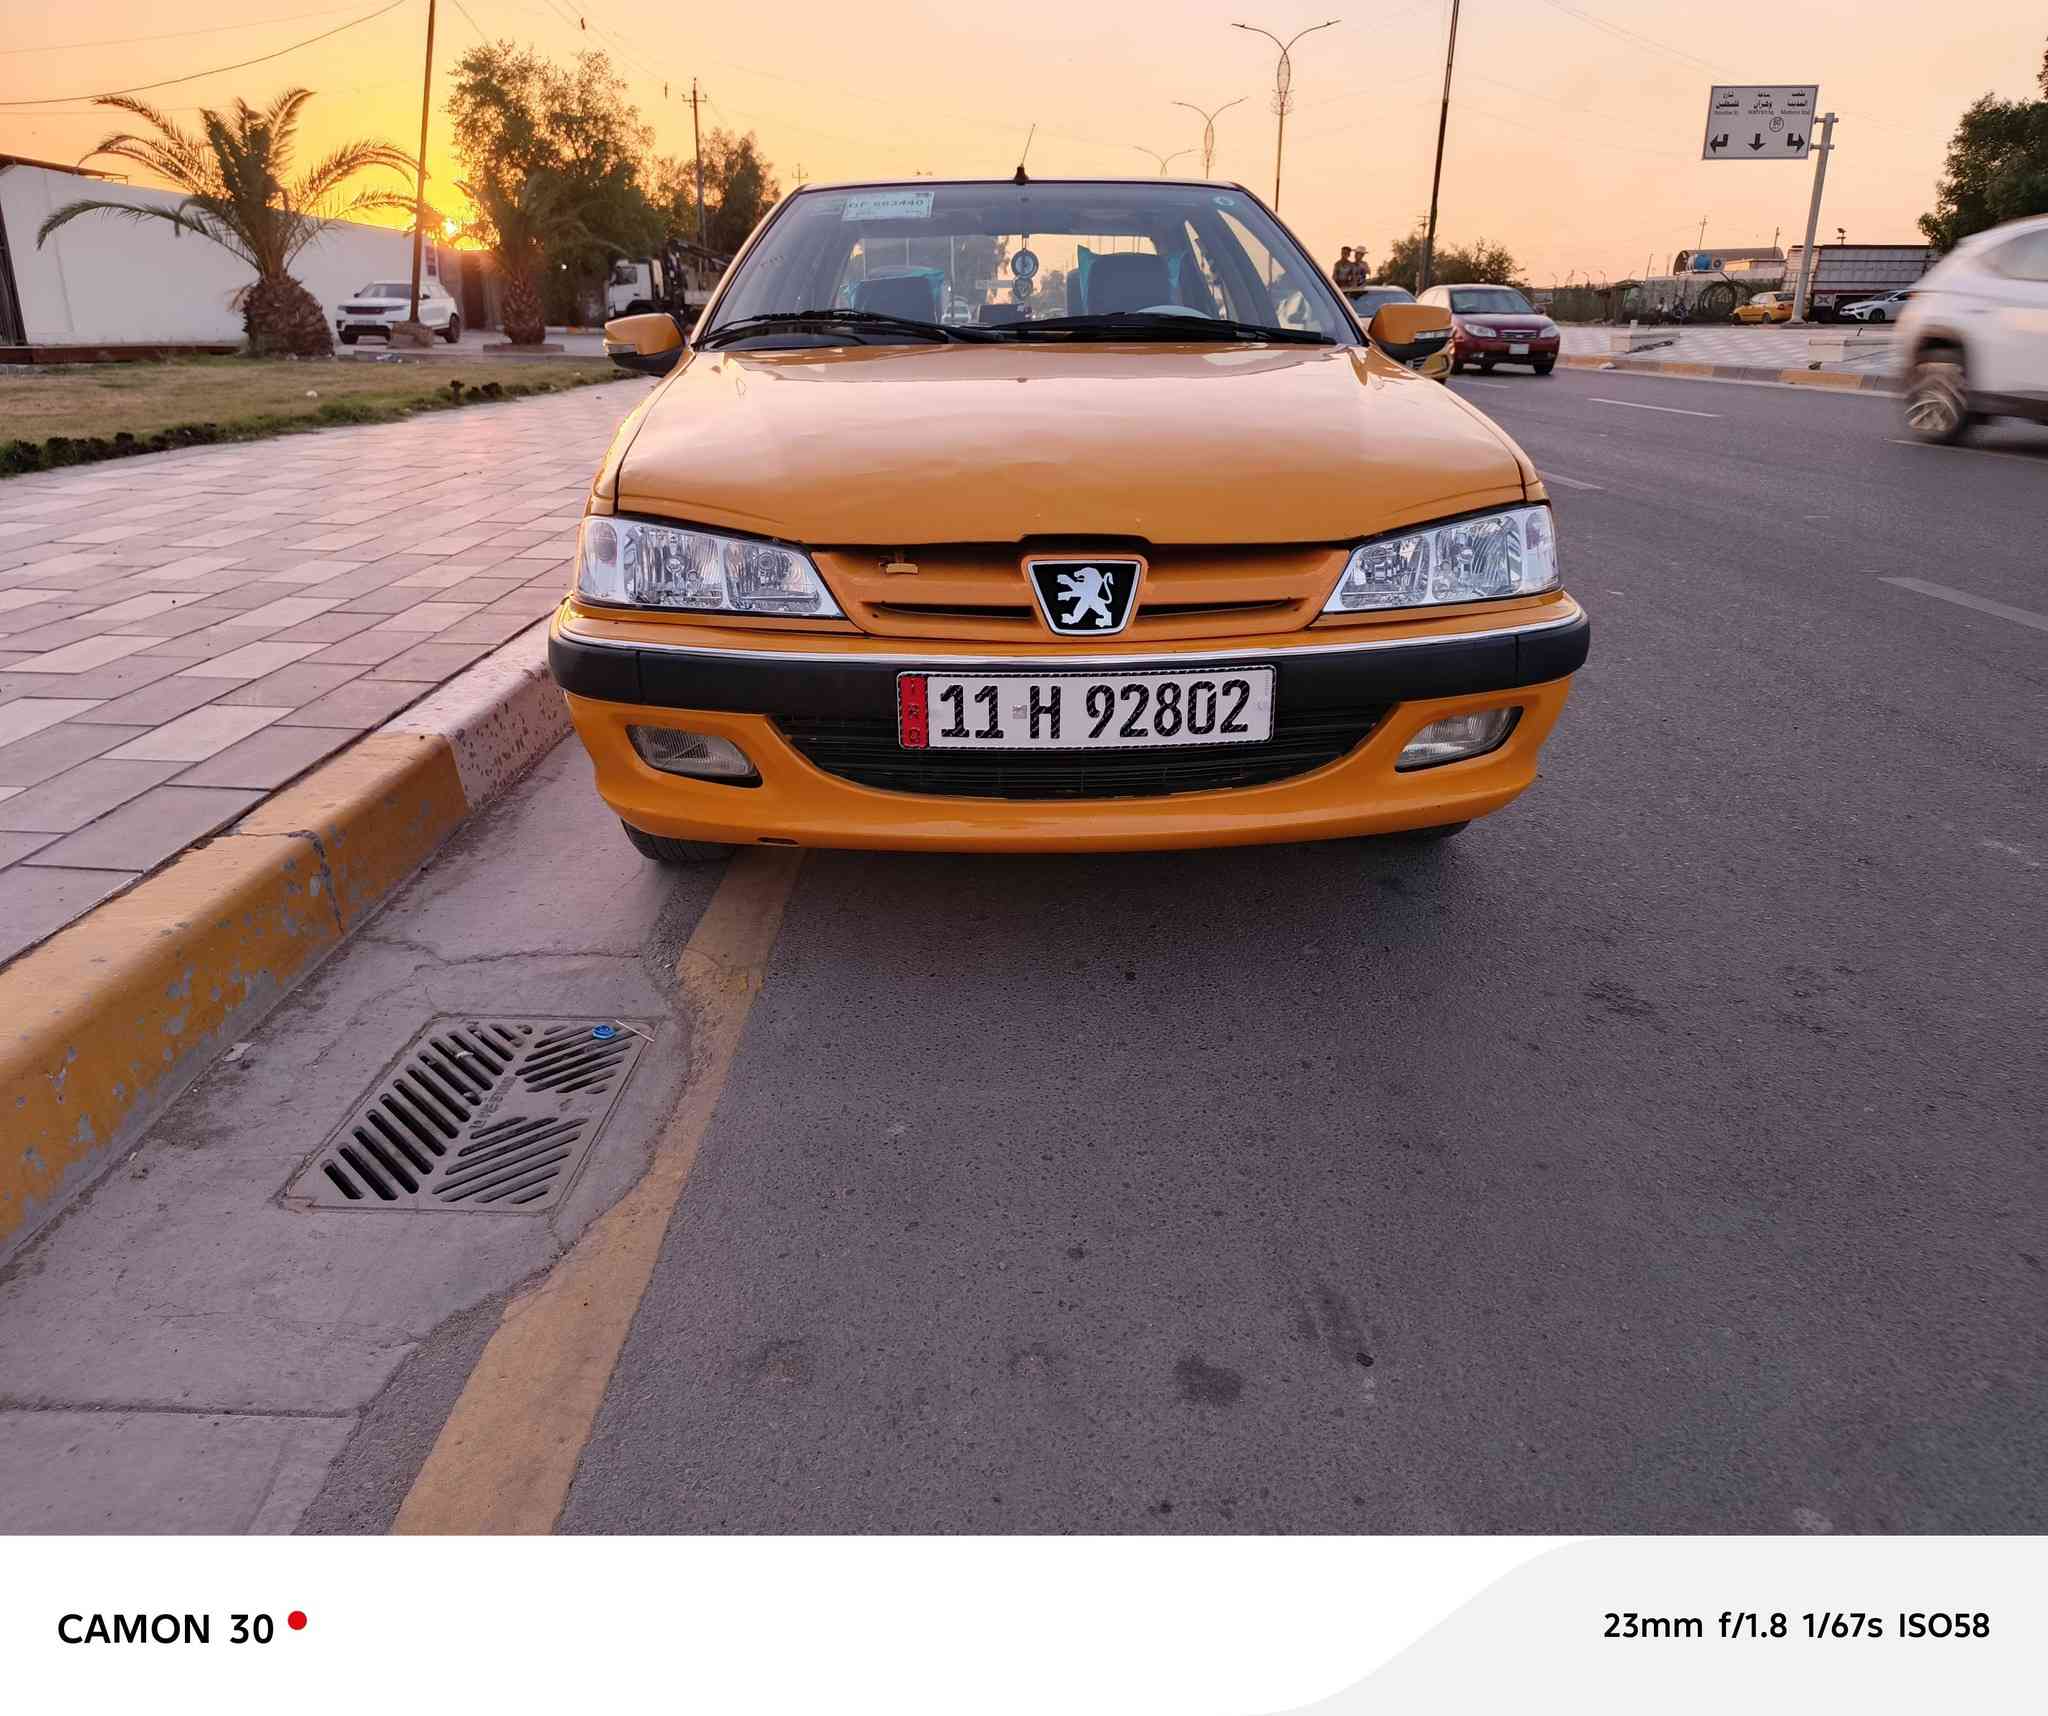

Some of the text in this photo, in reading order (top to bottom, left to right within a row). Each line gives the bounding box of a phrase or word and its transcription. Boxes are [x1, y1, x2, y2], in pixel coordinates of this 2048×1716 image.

[940, 685, 1005, 739] 11
[1029, 685, 1062, 739] H
[1086, 679, 1251, 738] 92802
